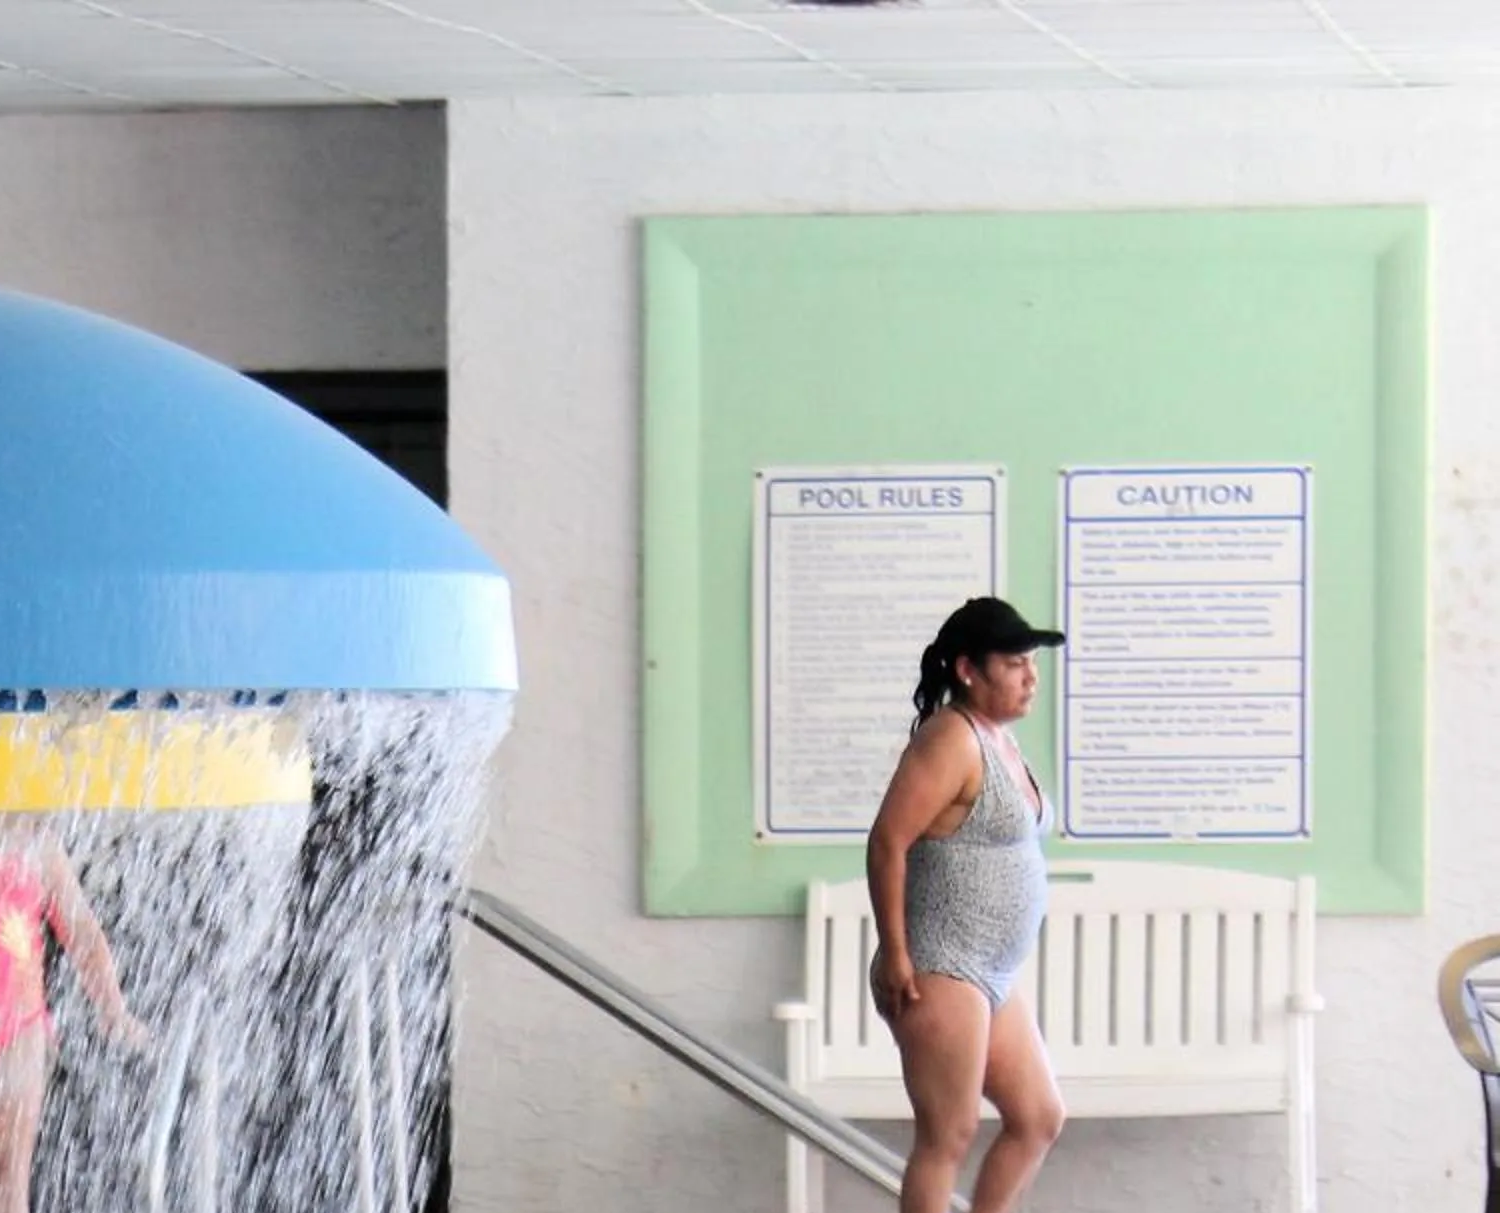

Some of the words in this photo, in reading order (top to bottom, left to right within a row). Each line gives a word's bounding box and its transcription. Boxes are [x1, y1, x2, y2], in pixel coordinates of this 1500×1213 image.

[798, 487, 870, 508] POOL
[878, 486, 965, 508] RULES
[1117, 484, 1254, 506] CAUTION
